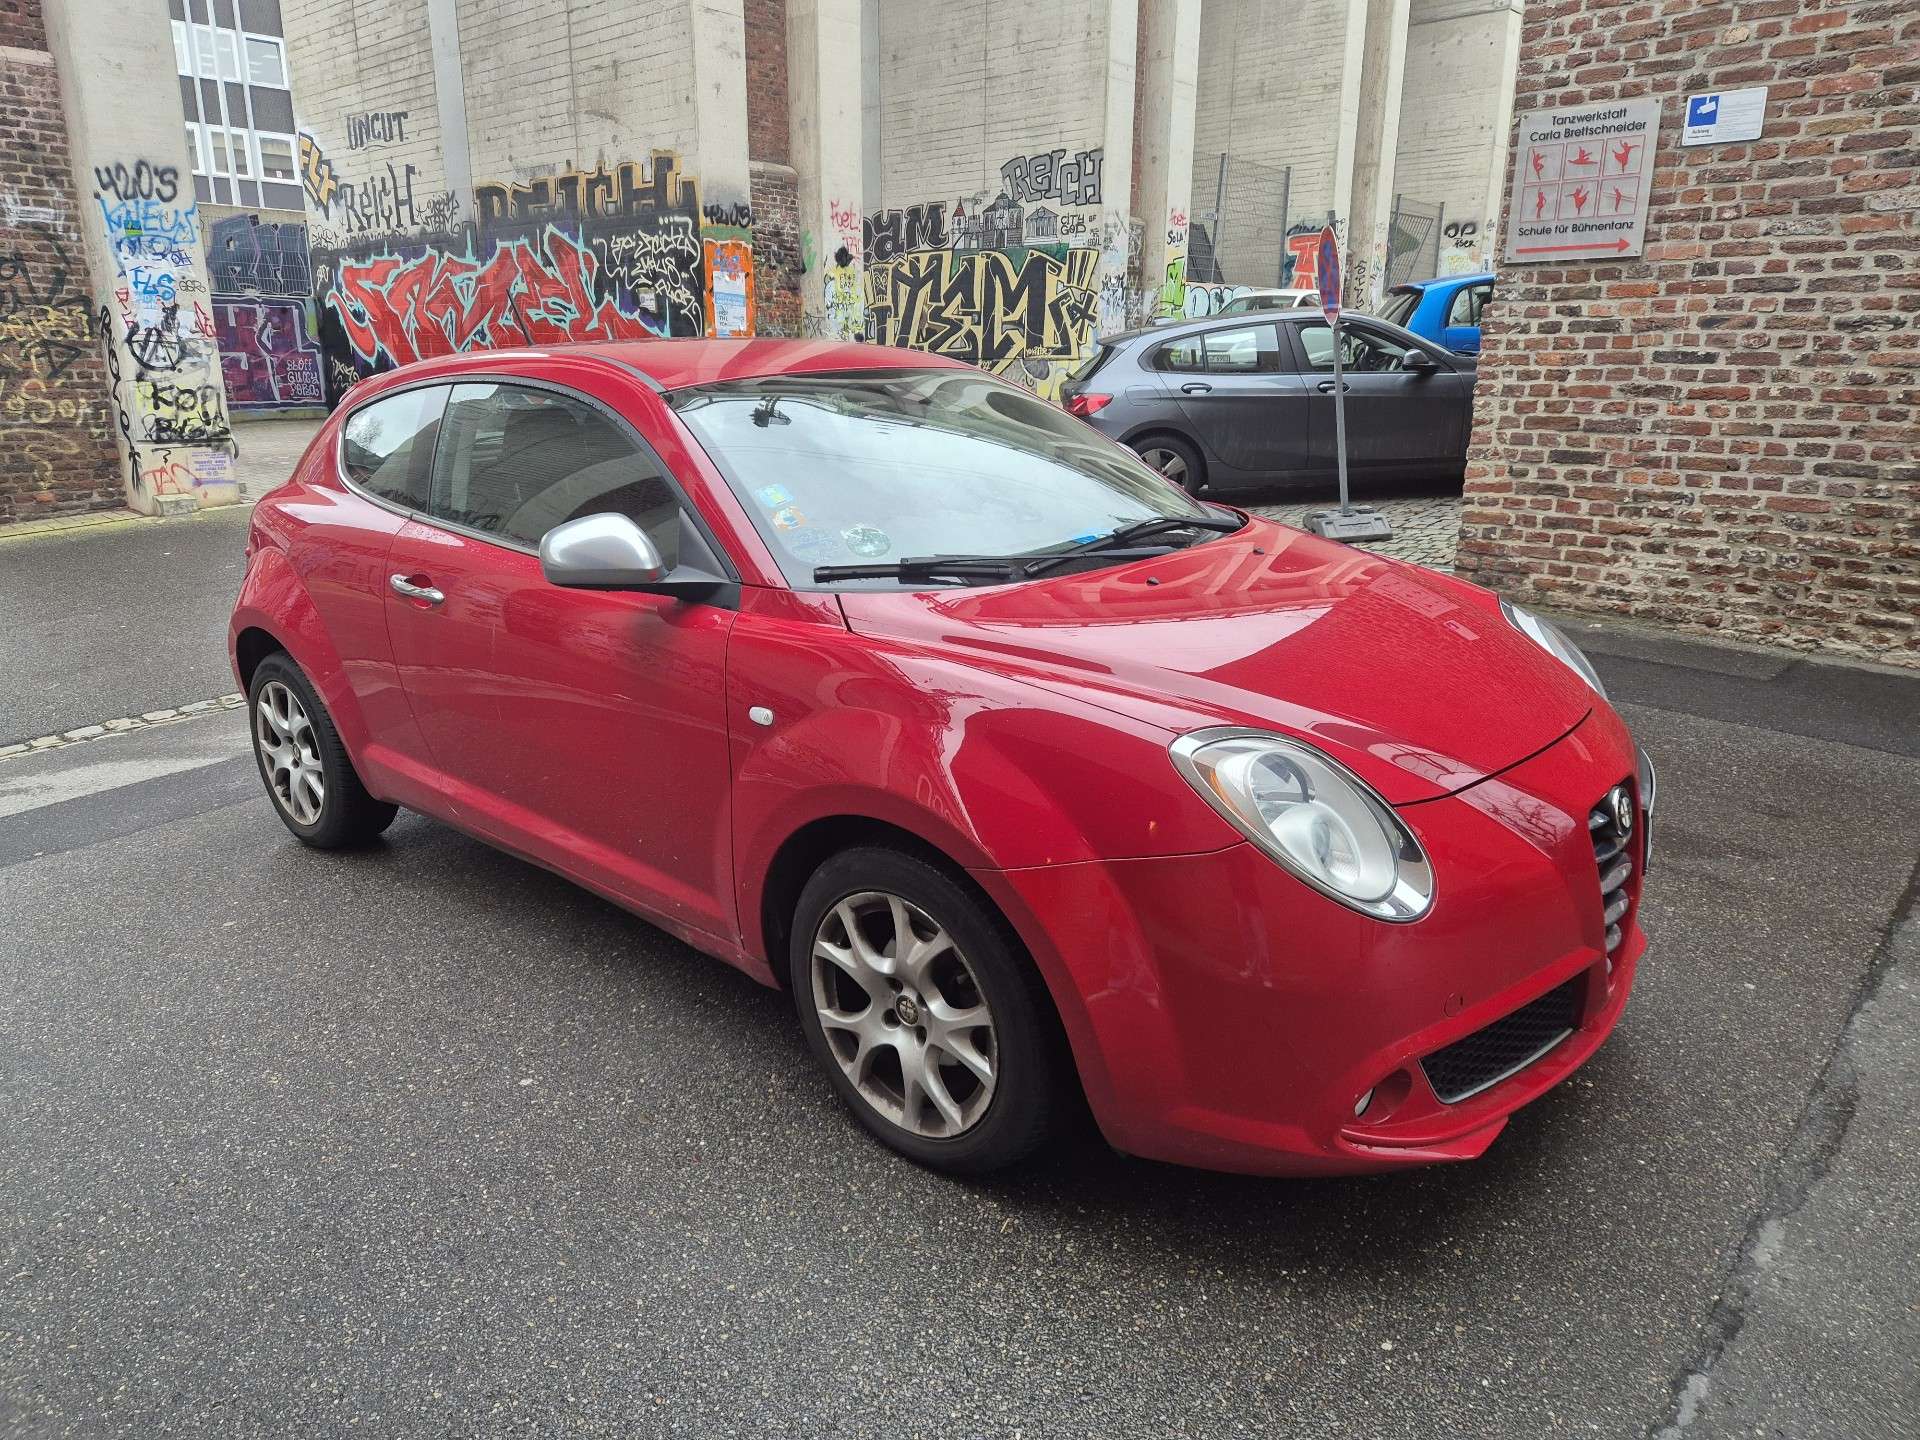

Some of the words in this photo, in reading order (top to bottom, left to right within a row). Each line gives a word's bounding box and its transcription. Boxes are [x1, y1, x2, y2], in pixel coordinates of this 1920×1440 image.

[1552, 108, 1628, 126] Tanzwerkstatt
[1530, 130, 1561, 142] Carla
[1564, 121, 1647, 138] Brettschneider
[1060, 224, 1086, 236] GOD
[1518, 224, 1552, 237] Schule
[1555, 222, 1569, 234] für
[1572, 220, 1634, 233] Bühnentanz
